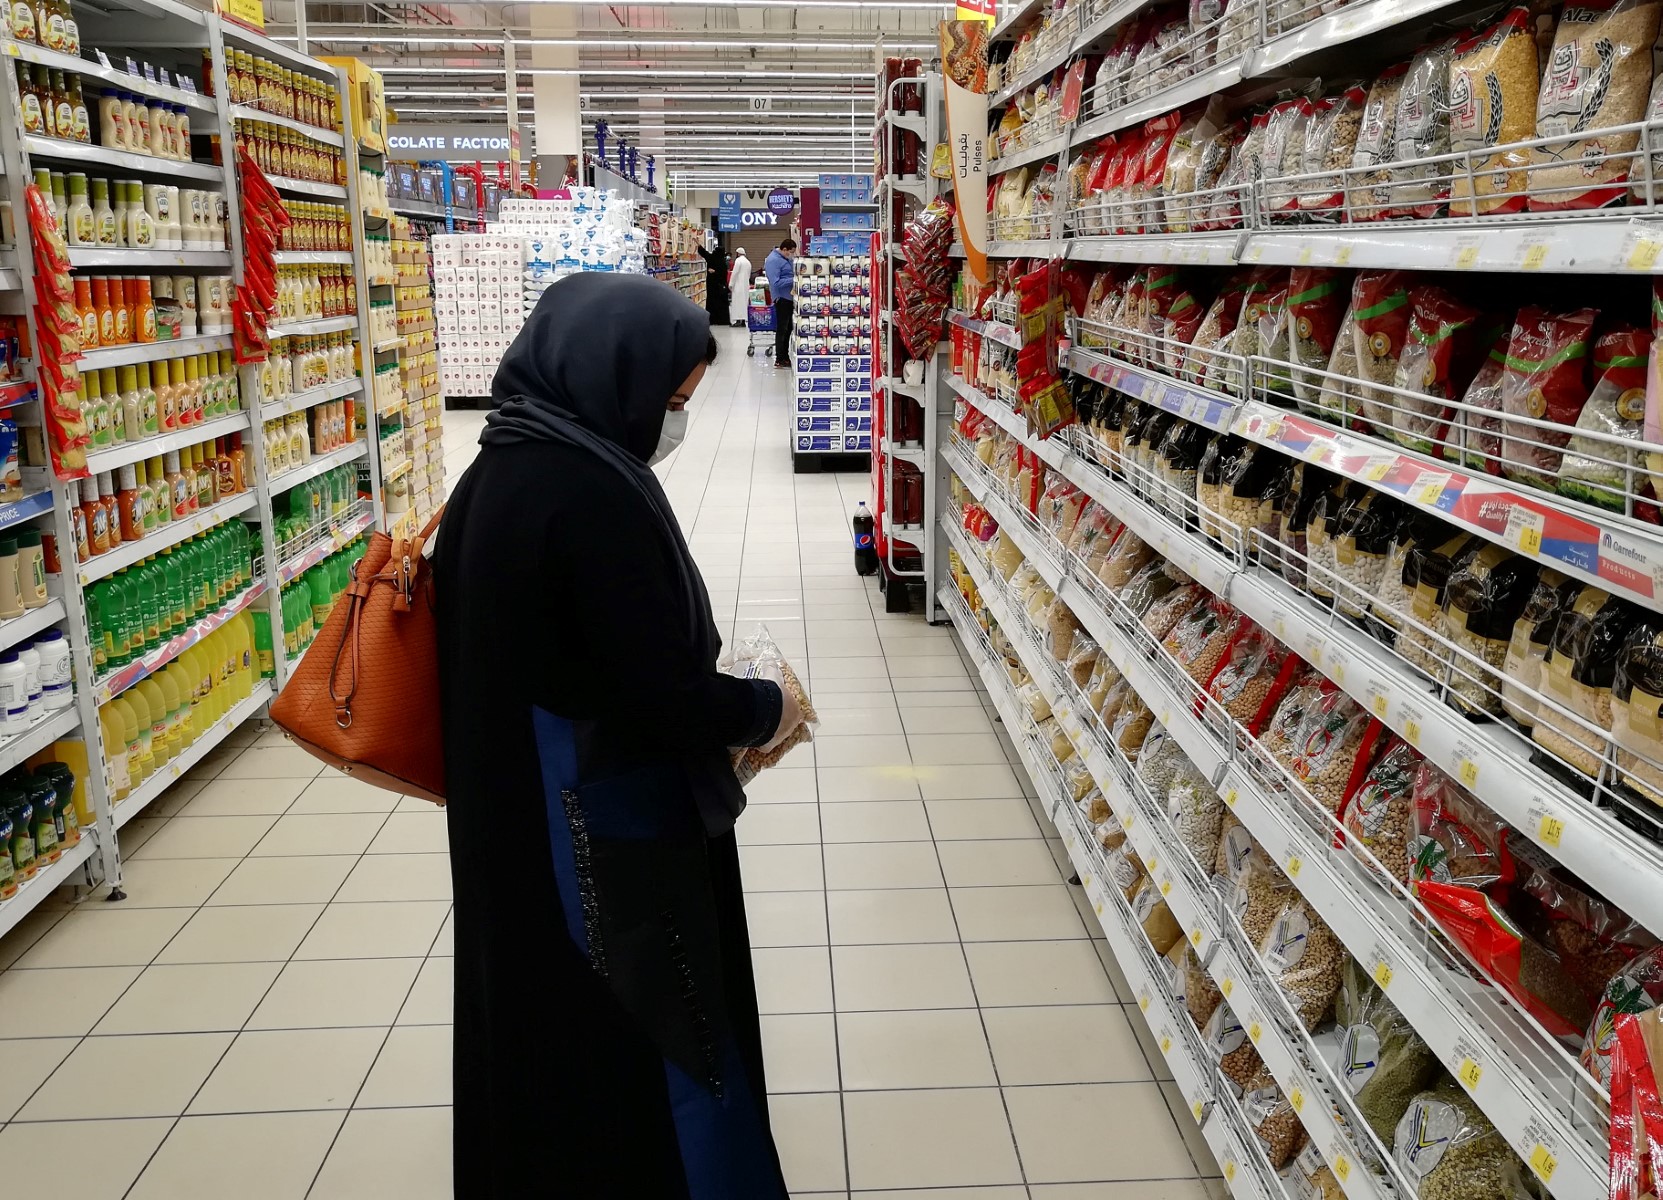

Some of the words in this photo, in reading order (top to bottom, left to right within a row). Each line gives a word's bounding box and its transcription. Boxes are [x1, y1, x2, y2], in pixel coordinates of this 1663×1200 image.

[755, 98, 767, 109] 07
[388, 136, 446, 149] COLATE
[453, 137, 510, 150] FACTOR
[973, 140, 983, 172] Pulses
[740, 212, 778, 226] ONY
[0, 507, 20, 522] PRICE
[1613, 541, 1647, 564] Carrefour
[1602, 559, 1636, 580] Products
